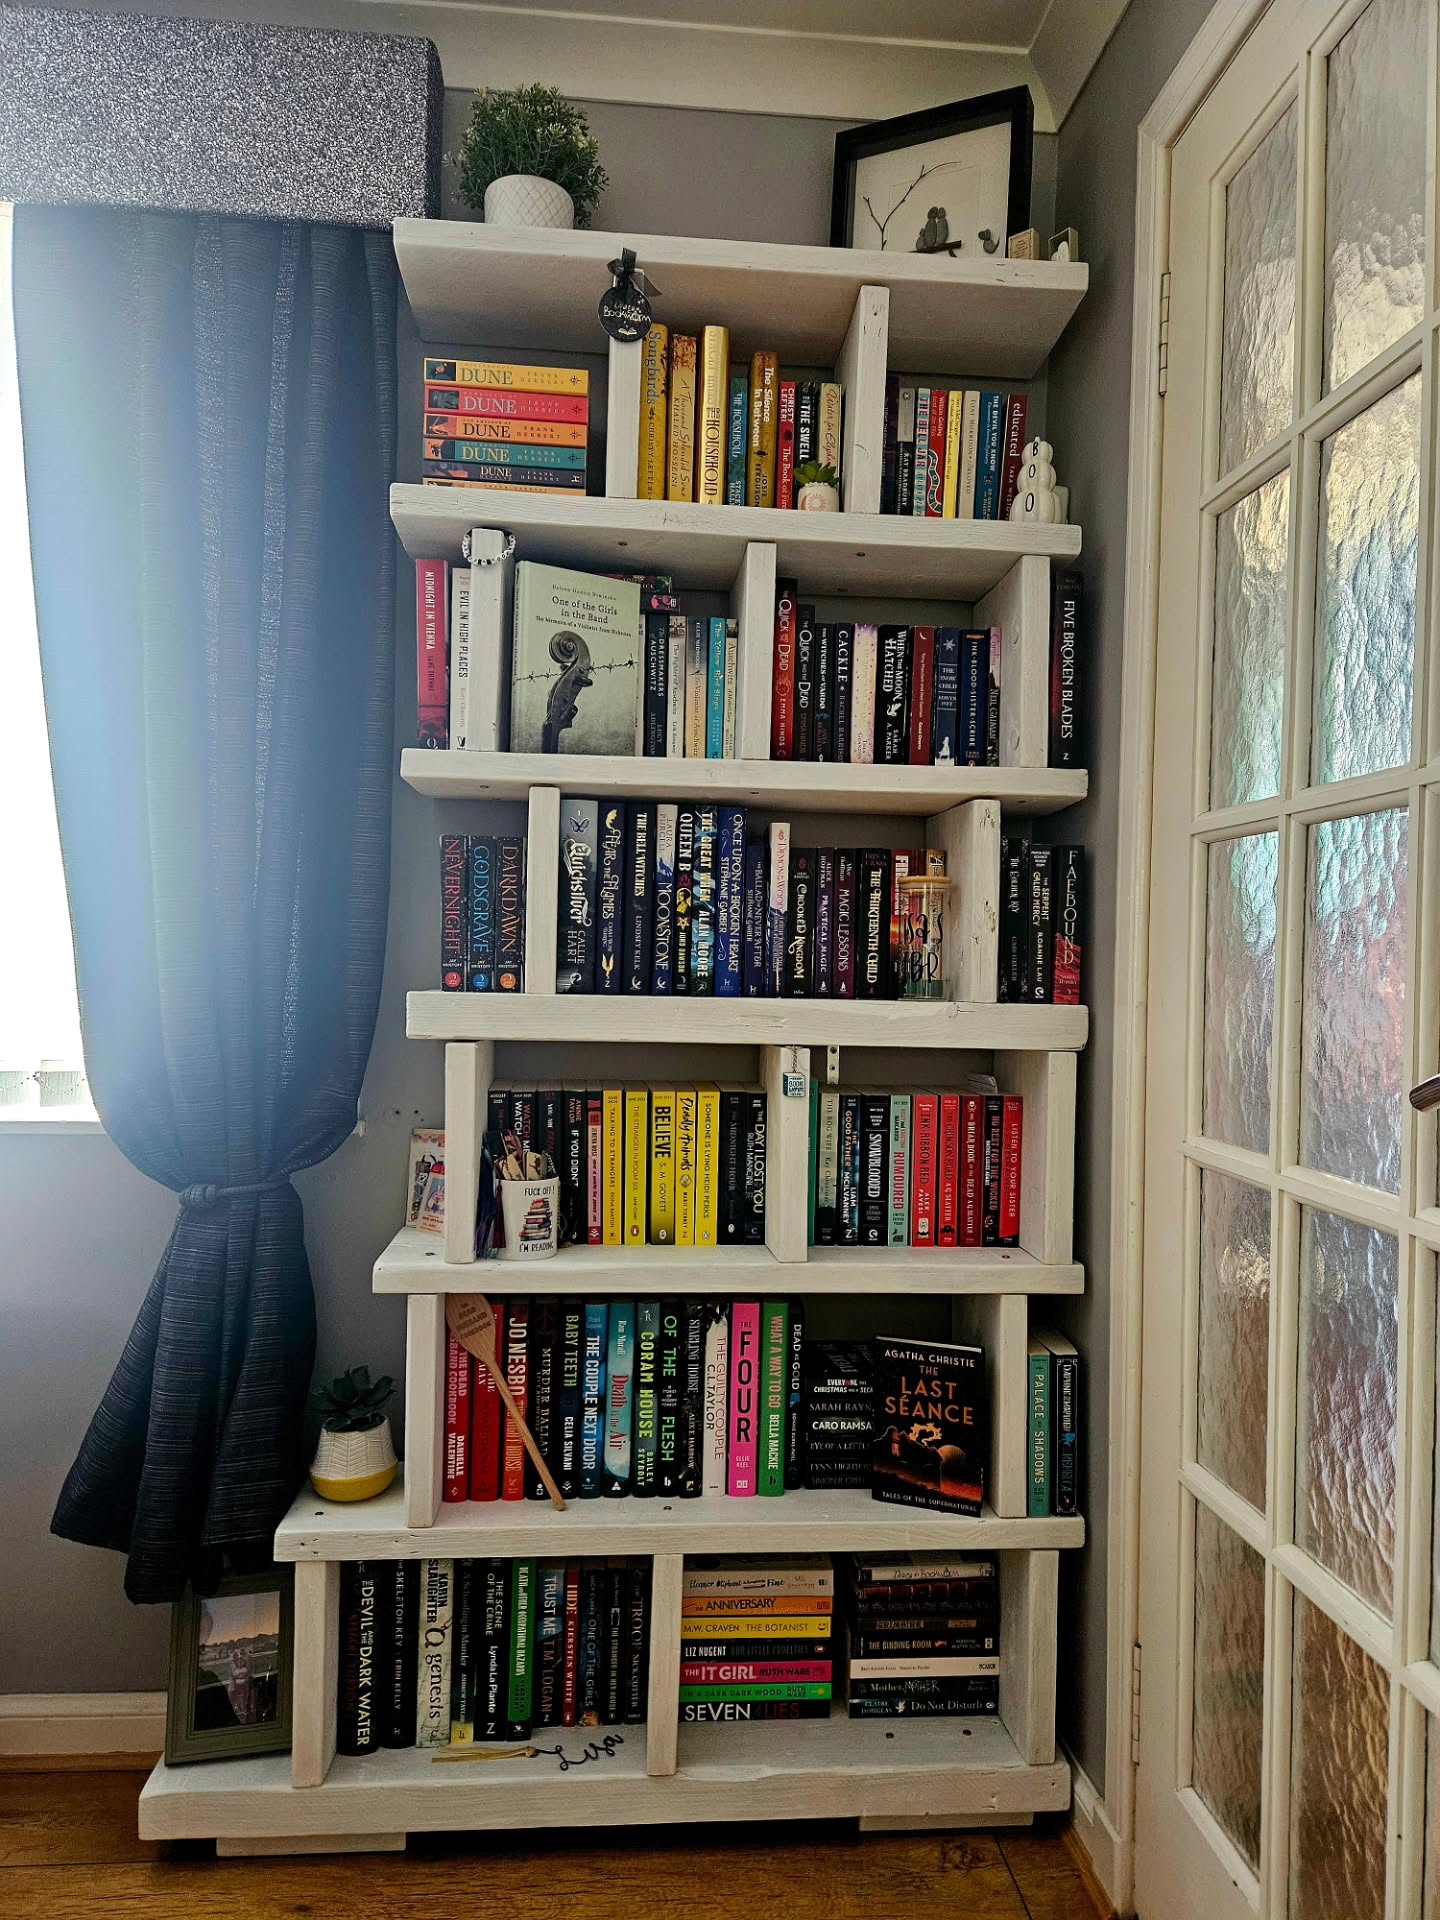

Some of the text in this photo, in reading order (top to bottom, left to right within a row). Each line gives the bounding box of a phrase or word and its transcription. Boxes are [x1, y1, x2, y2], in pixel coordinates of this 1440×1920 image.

[461, 368, 513, 385] DUNE
[645, 332, 661, 404] Songbirds
[464, 397, 517, 414] DUNE
[764, 368, 773, 422] The Silence
[464, 423, 511, 438] DUNE
[800, 405, 810, 460] THE SWELL
[1010, 403, 1023, 456] educated
[462, 447, 509, 462] DUNE
[480, 466, 512, 476] DUNE
[425, 572, 435, 650] MIDNIGHT IN VIENNA
[552, 596, 618, 615] One of the Girls
[561, 608, 608, 624] in the Band
[459, 590, 469, 678] EVIL IN HIGH PLACES
[837, 631, 848, 682] CACKLE
[727, 642, 736, 685] Auschwitz
[778, 644, 791, 670] DEAD
[883, 639, 895, 692] HATCHED
[1061, 601, 1074, 738] FIVE BROKEN BLADES
[679, 813, 693, 871] QUEEN B
[445, 839, 464, 954] NEVERNIGHT
[473, 846, 492, 952] GODSGRAVE
[499, 846, 520, 952] DARKDAWN
[564, 838, 592, 926] Quicksilver
[655, 883, 672, 970] MOONSTONE
[838, 889, 850, 971] MAGIC LESSONS
[1064, 851, 1079, 964] FAEBOUND
[568, 931, 577, 963] HART
[577, 930, 586, 964] CALLIE
[696, 911, 710, 977] ALAN MOORE
[820, 944, 828, 972] MAGIC
[514, 1101, 522, 1135] WATCH
[655, 1106, 671, 1158] BELIEVE
[610, 1139, 615, 1147] TO
[867, 1134, 881, 1197] SNOWBLOODED
[1011, 1153, 1017, 1163] TO
[893, 1152, 904, 1209] RUMOURED
[664, 1316, 676, 1337] OF
[563, 1315, 578, 1386] BABY TEETH
[663, 1348, 676, 1377] THE
[885, 1350, 975, 1367] AGATHA CHRISTIE
[920, 1366, 938, 1375] THE
[458, 1351, 467, 1396] THE DEAD
[639, 1332, 655, 1438] CORAM HOUSE
[736, 1331, 752, 1443] FOUR
[902, 1376, 957, 1399] LAST
[1034, 1374, 1044, 1418] PALACE
[582, 1336, 599, 1469] THE COUPLE NEXT DOOR
[714, 1337, 726, 1460] THE GUILTY COUPLE
[885, 1395, 974, 1425] SÉANCE
[448, 1433, 456, 1479] VALENTINE
[456, 1435, 464, 1476] DANIELLE
[563, 1416, 574, 1470] CELIA SILVANI
[661, 1416, 675, 1461] FLESH
[768, 1414, 780, 1470] BELLA MACKIE
[1035, 1431, 1044, 1483] SHADOWS
[427, 1560, 437, 1623] SLAUGHTER
[438, 1573, 447, 1607] KARIN
[488, 1573, 494, 1586] OF
[566, 1585, 577, 1615] HIDE
[361, 1587, 374, 1629] DEVIL
[495, 1580, 503, 1628] THE SCENE
[544, 1576, 556, 1634] TRUST ME
[395, 1628, 403, 1646] KEY
[685, 1647, 696, 1656] LIZ
[699, 1646, 726, 1656] NUGENT
[869, 1641, 931, 1650] THE BINDING ROOM
[426, 1653, 444, 1719] genesis
[701, 1667, 717, 1680] IT
[719, 1666, 757, 1679] GIRL
[357, 1647, 372, 1746] DARK WATER
[685, 1703, 799, 1720] SEVEN LIES
[911, 1701, 982, 1711] Do Not Disturb
